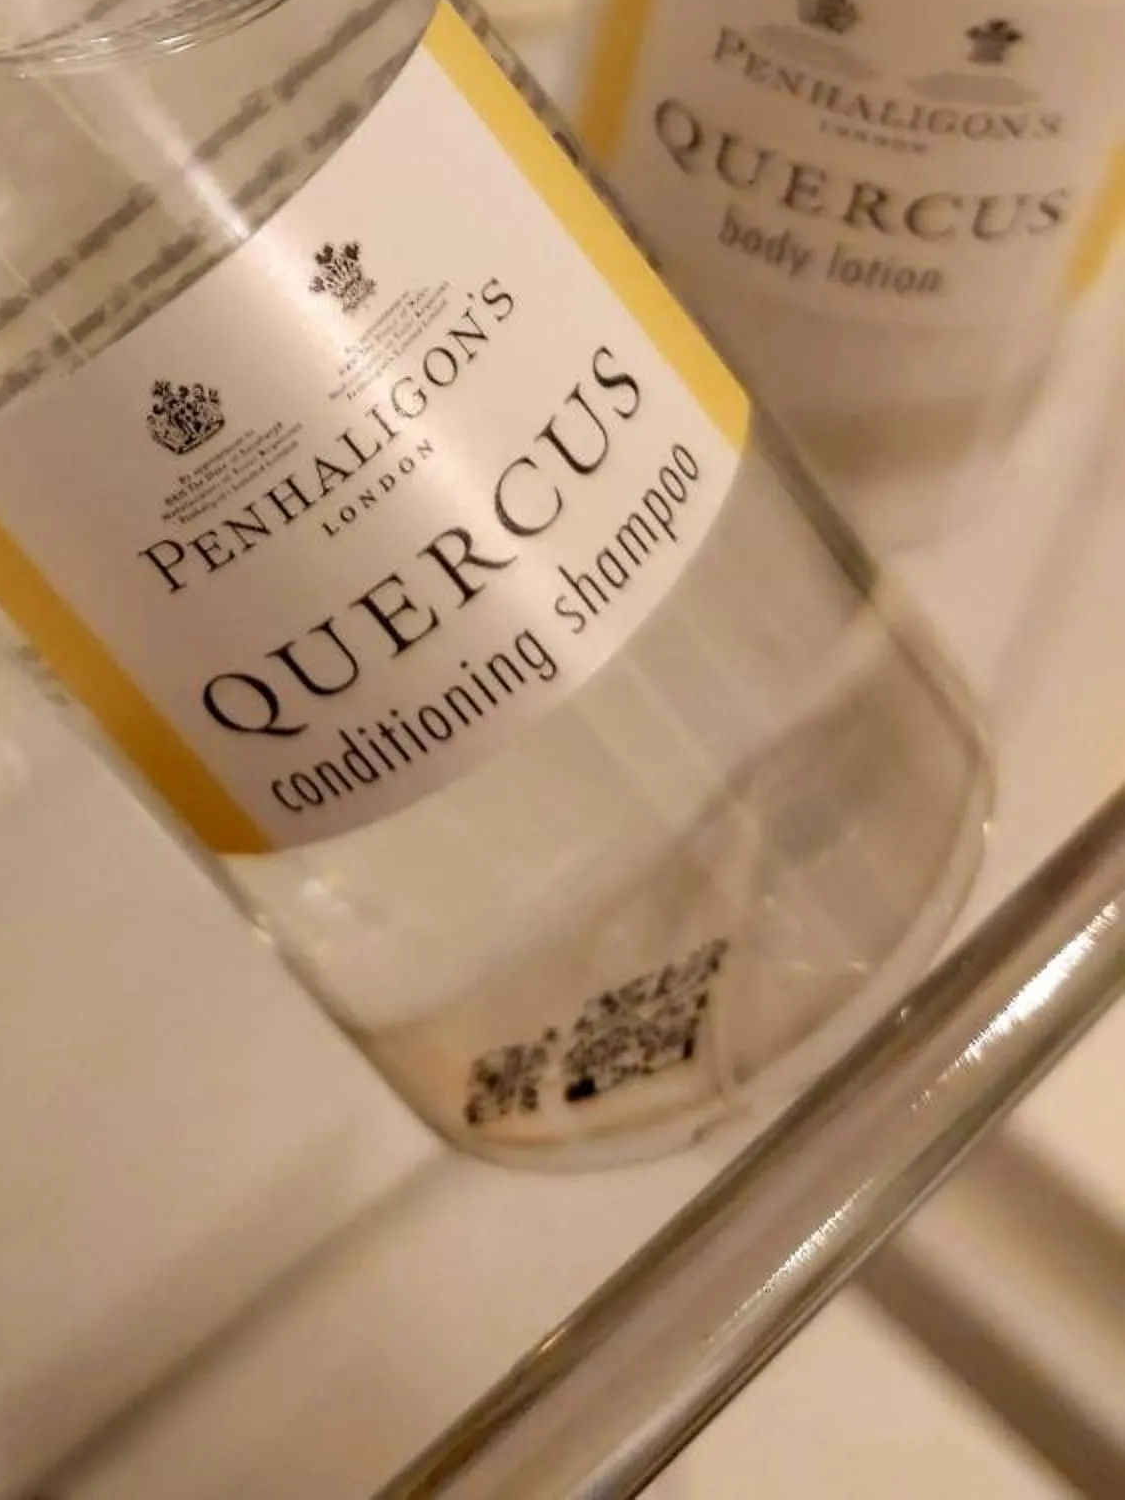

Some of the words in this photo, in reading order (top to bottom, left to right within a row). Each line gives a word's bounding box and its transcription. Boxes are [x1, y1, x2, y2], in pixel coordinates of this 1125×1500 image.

[714, 26, 1063, 141] PENHALIGONS
[652, 97, 1071, 243] QUERCUS
[718, 204, 812, 279] body
[825, 242, 946, 295] lotion
[138, 276, 516, 595] PENHALIGON'S
[321, 437, 436, 539] LONDON
[201, 345, 642, 739] QUERCUS
[271, 627, 560, 813] conditioning
[552, 443, 701, 635] shampoo
